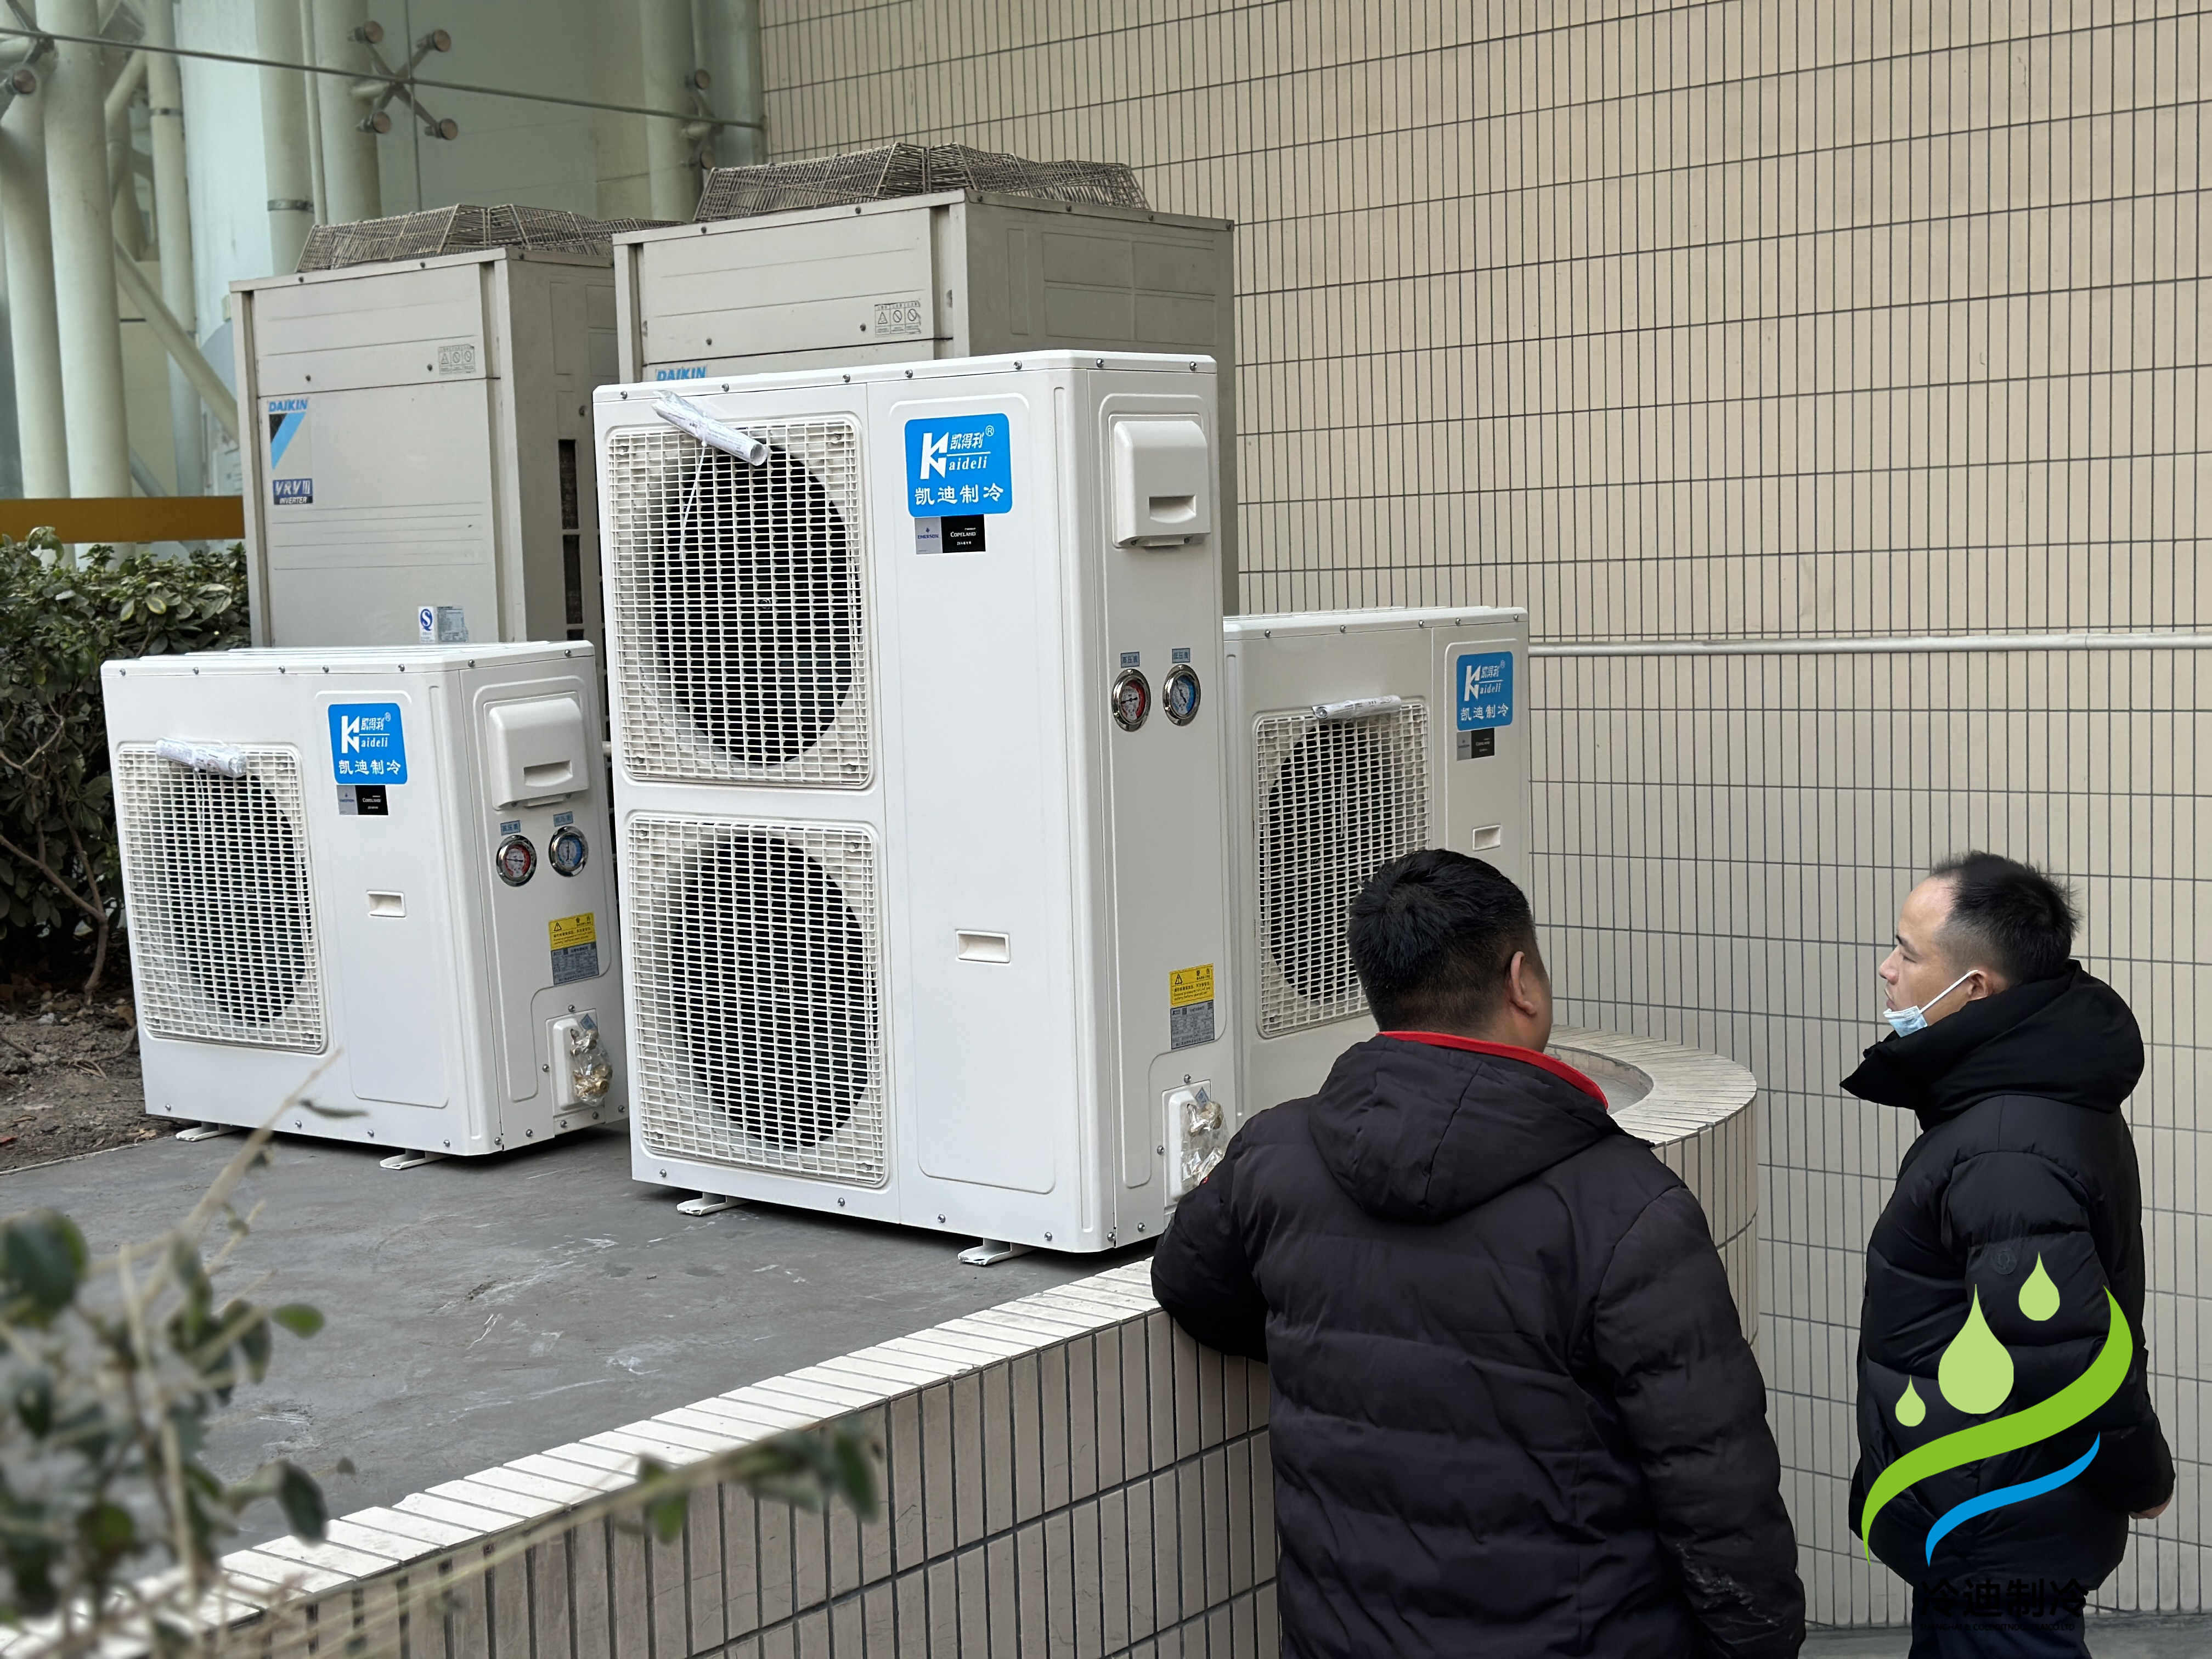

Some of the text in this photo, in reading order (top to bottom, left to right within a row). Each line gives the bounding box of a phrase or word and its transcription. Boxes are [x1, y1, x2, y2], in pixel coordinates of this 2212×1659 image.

[657, 366, 707, 381] DAIKIN
[268, 399, 308, 412] DAIKIN
[950, 432, 984, 449] 凯得利
[920, 432, 988, 479] Kaideli
[279, 496, 307, 504] INVERTER
[915, 483, 1004, 506] 凯迪制冷
[1460, 703, 1509, 721] 凯迪制冷
[341, 715, 388, 753] Kaideli
[338, 759, 401, 775] 凯迪制冷
